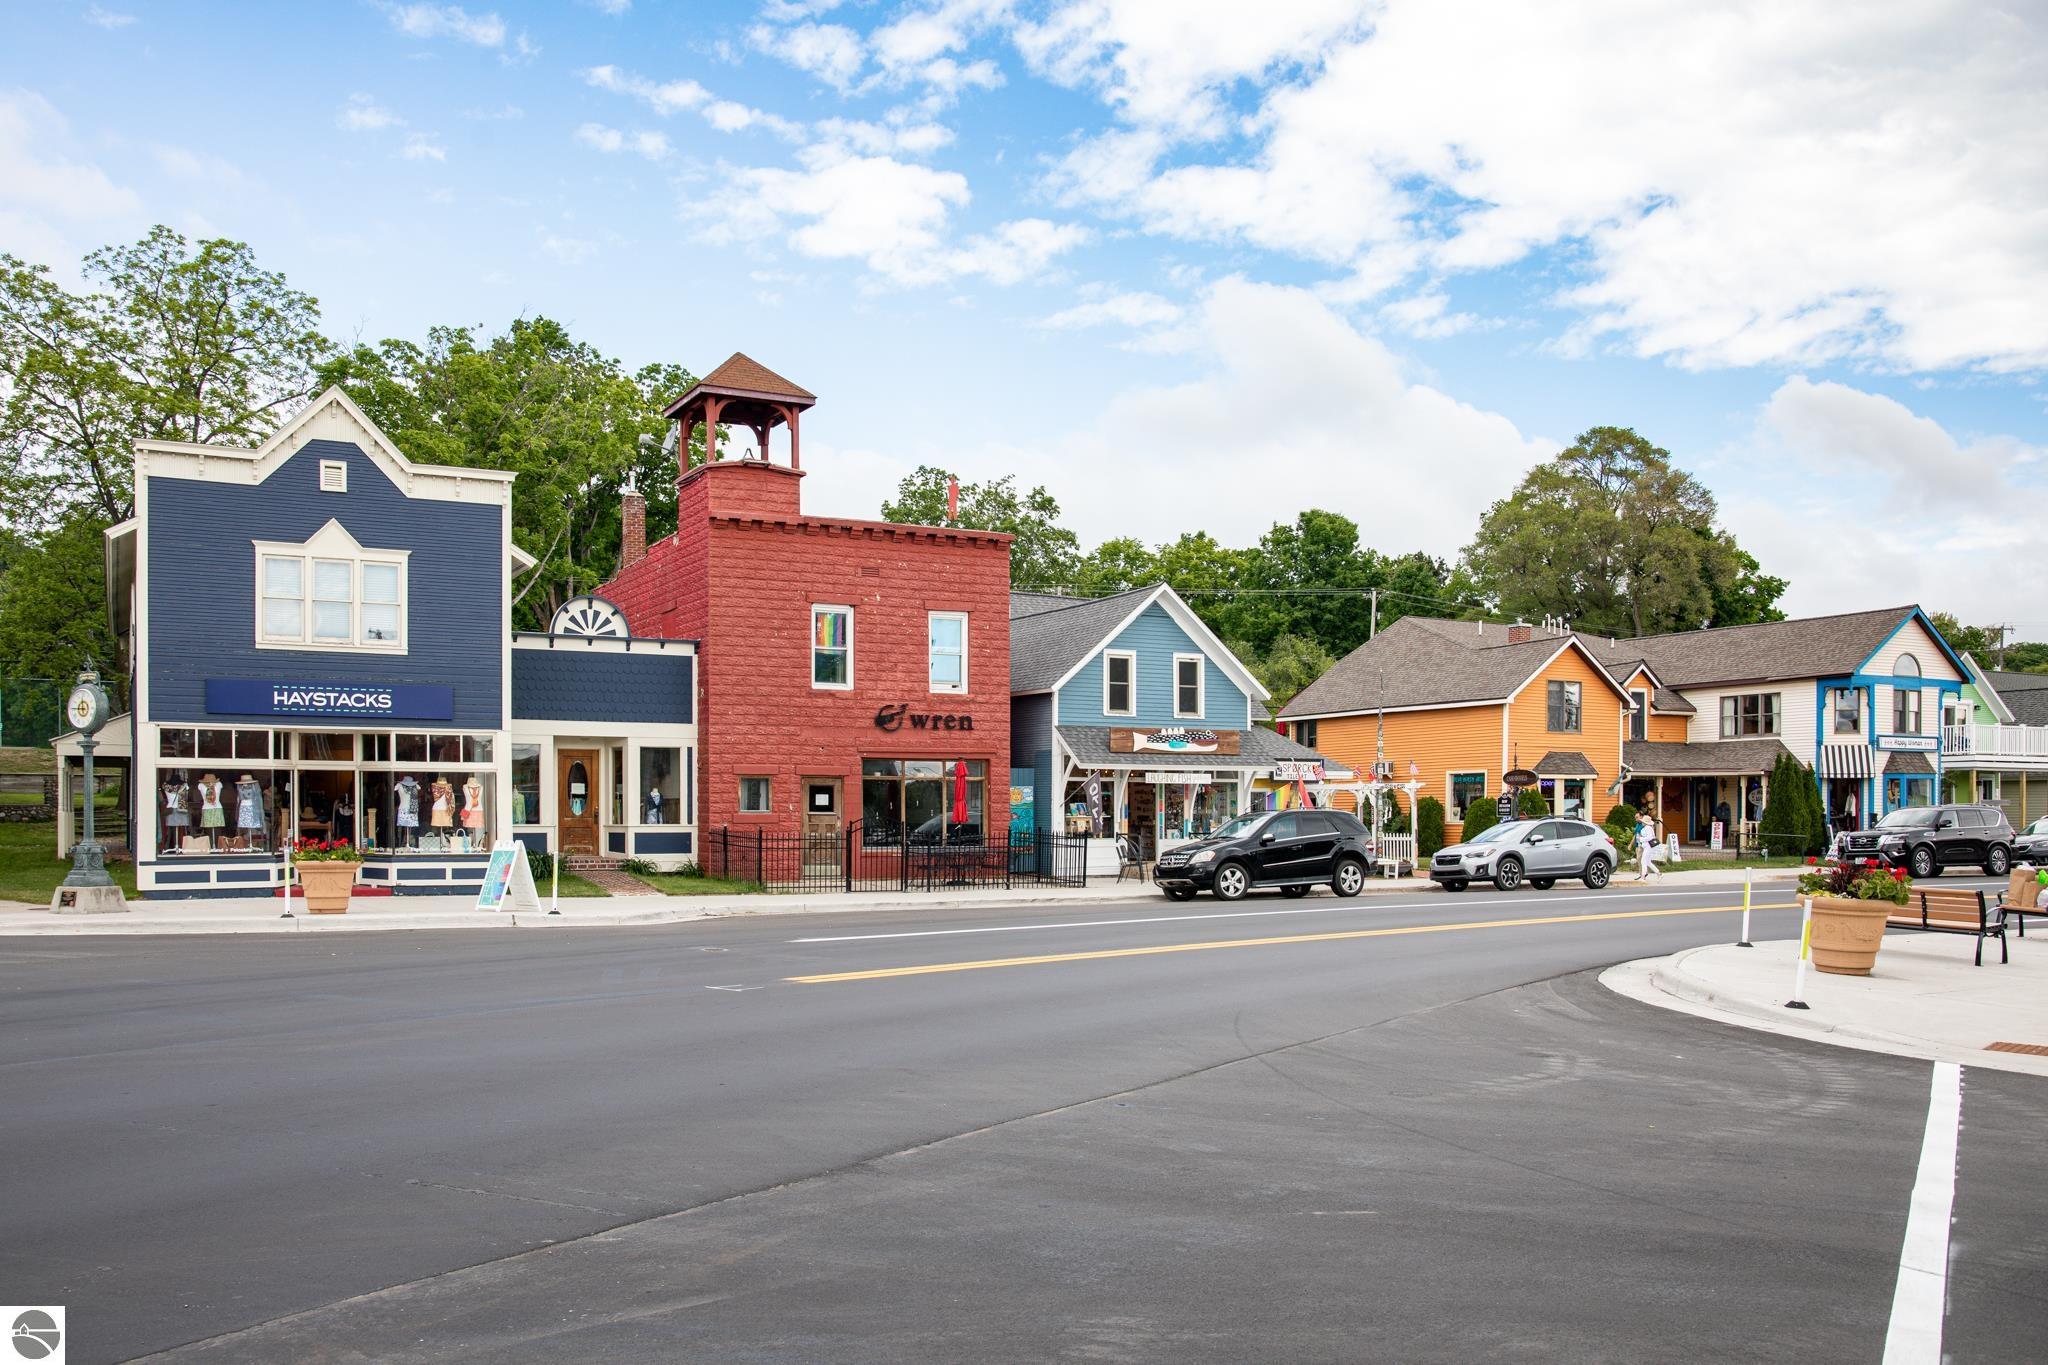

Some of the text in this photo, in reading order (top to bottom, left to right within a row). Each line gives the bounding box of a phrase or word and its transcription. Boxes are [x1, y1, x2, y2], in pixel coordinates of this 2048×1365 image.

[273, 691, 392, 708] HAYSTACKS
[909, 713, 974, 731] wren
[1147, 773, 1175, 783] LAUGHING
[1177, 774, 1192, 784] FISH
[1712, 822, 1721, 840] OPEN
